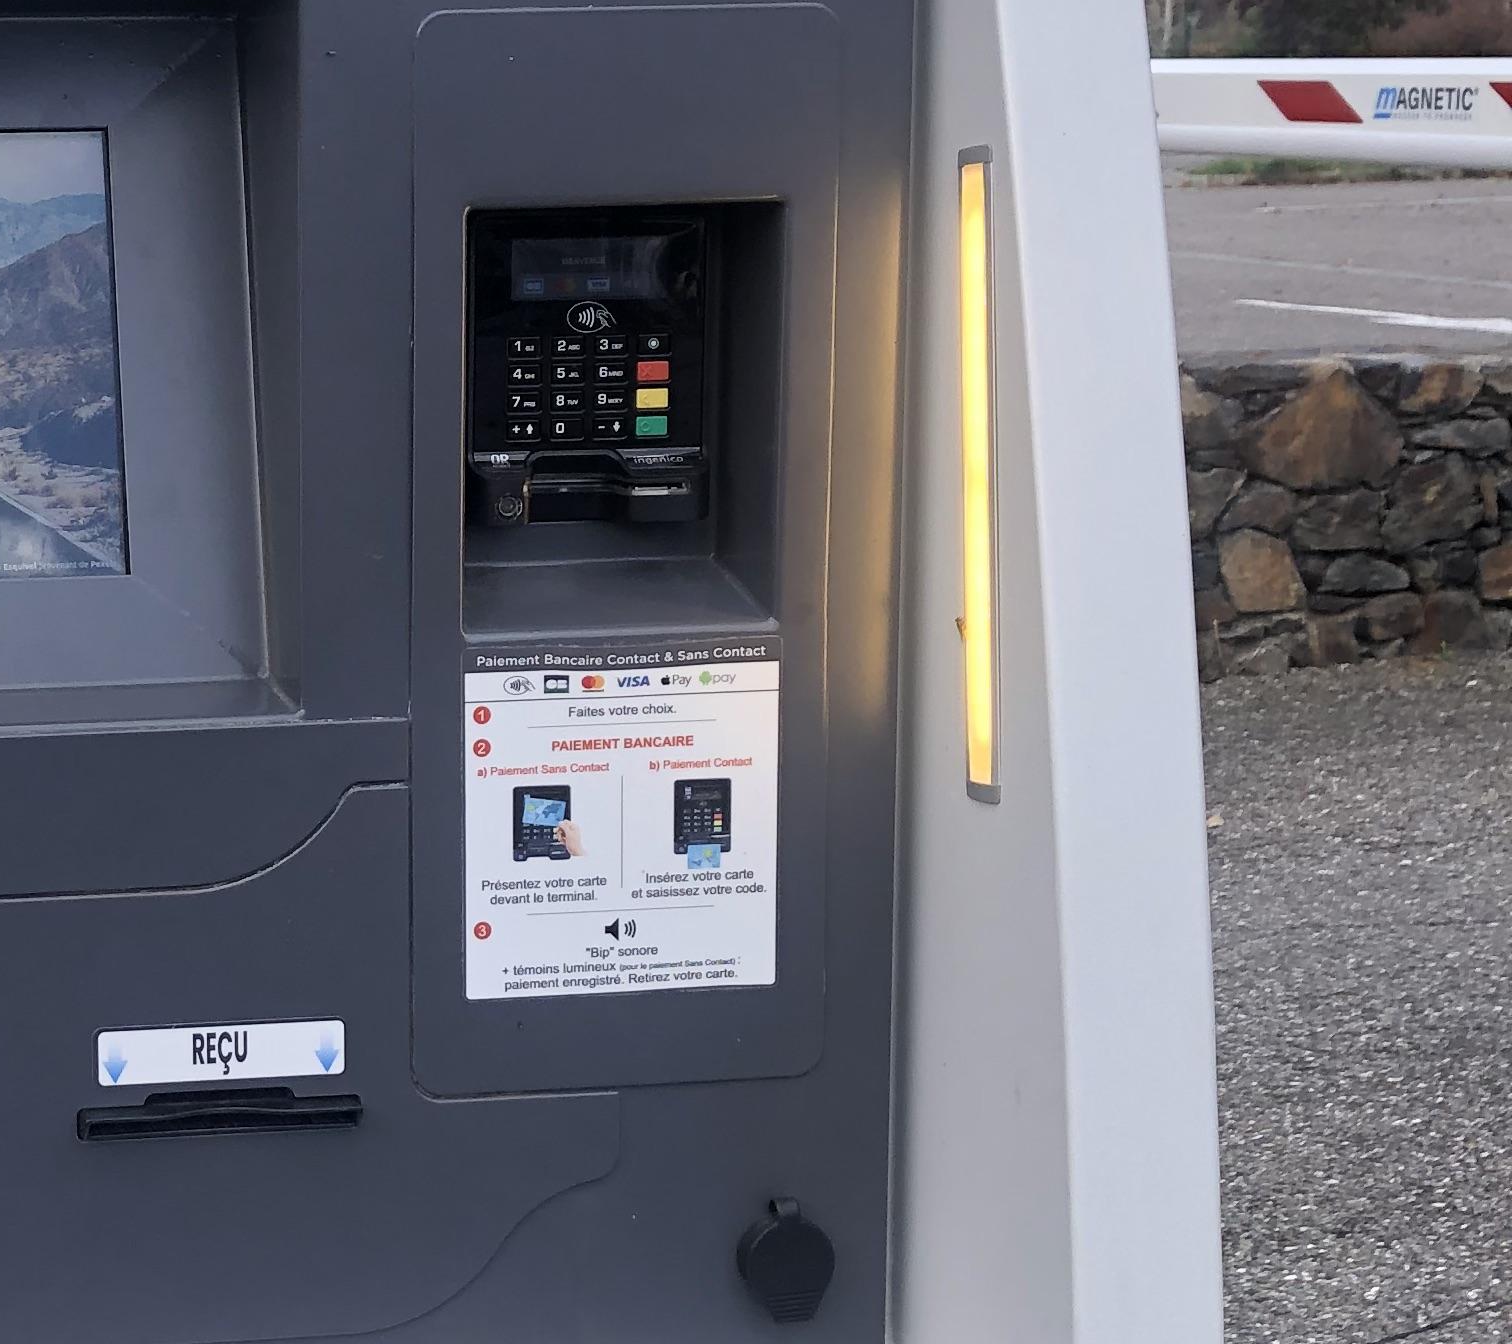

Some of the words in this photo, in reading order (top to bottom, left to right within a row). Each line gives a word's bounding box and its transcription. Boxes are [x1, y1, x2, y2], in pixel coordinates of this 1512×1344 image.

[514, 341, 521, 351] 1
[557, 340, 566, 351] 2
[599, 339, 608, 350] 3
[513, 368, 522, 379] 4
[557, 368, 565, 378] 5
[599, 367, 608, 377] 6
[512, 396, 521, 407] 7
[556, 395, 564, 406] 8
[598, 394, 606, 404] 9
[556, 422, 564, 433] 0
[476, 655, 540, 667] Paiement
[544, 653, 603, 666] Bancaire
[607, 652, 660, 665] Contact
[664, 652, 674, 663] &
[677, 650, 709, 661] Sans
[713, 645, 767, 658] Contact
[617, 675, 651, 687] VISA
[672, 675, 692, 687] Pay
[713, 673, 737, 685] pay
[568, 706, 605, 717] Faites
[608, 706, 638, 716] votre
[641, 703, 676, 715] choix.
[552, 738, 620, 752] PAIEMENT
[624, 735, 694, 749] BANCAIRE
[477, 766, 488, 778] a)
[490, 764, 538, 776] Paiement
[541, 763, 568, 774] Sans
[570, 762, 610, 773] Contact
[649, 760, 660, 771] b)
[663, 758, 711, 770] Paiement
[712, 756, 753, 768] Contact
[481, 878, 541, 892] Présentez
[545, 877, 574, 888] votre
[577, 875, 607, 887] carte
[645, 871, 689, 884] Insérez
[692, 871, 722, 882] votre
[724, 869, 754, 880] carte
[490, 893, 530, 905] devant
[533, 892, 544, 904] le
[547, 890, 598, 903] terminal.
[631, 889, 643, 899] et
[646, 886, 700, 898] saisissez
[703, 885, 732, 896] votre
[735, 883, 768, 894] code.
[585, 946, 615, 959] "Bip"
[618, 946, 658, 957] sonore
[502, 967, 509, 975] +
[513, 962, 560, 976] témoins
[563, 961, 616, 974] lumineux
[504, 978, 561, 992] paiement
[563, 974, 626, 989] enregistré.
[628, 971, 670, 984] Retirez
[673, 970, 703, 981] votre
[705, 967, 739, 979] carte.
[192, 1030, 248, 1075] REÇU
